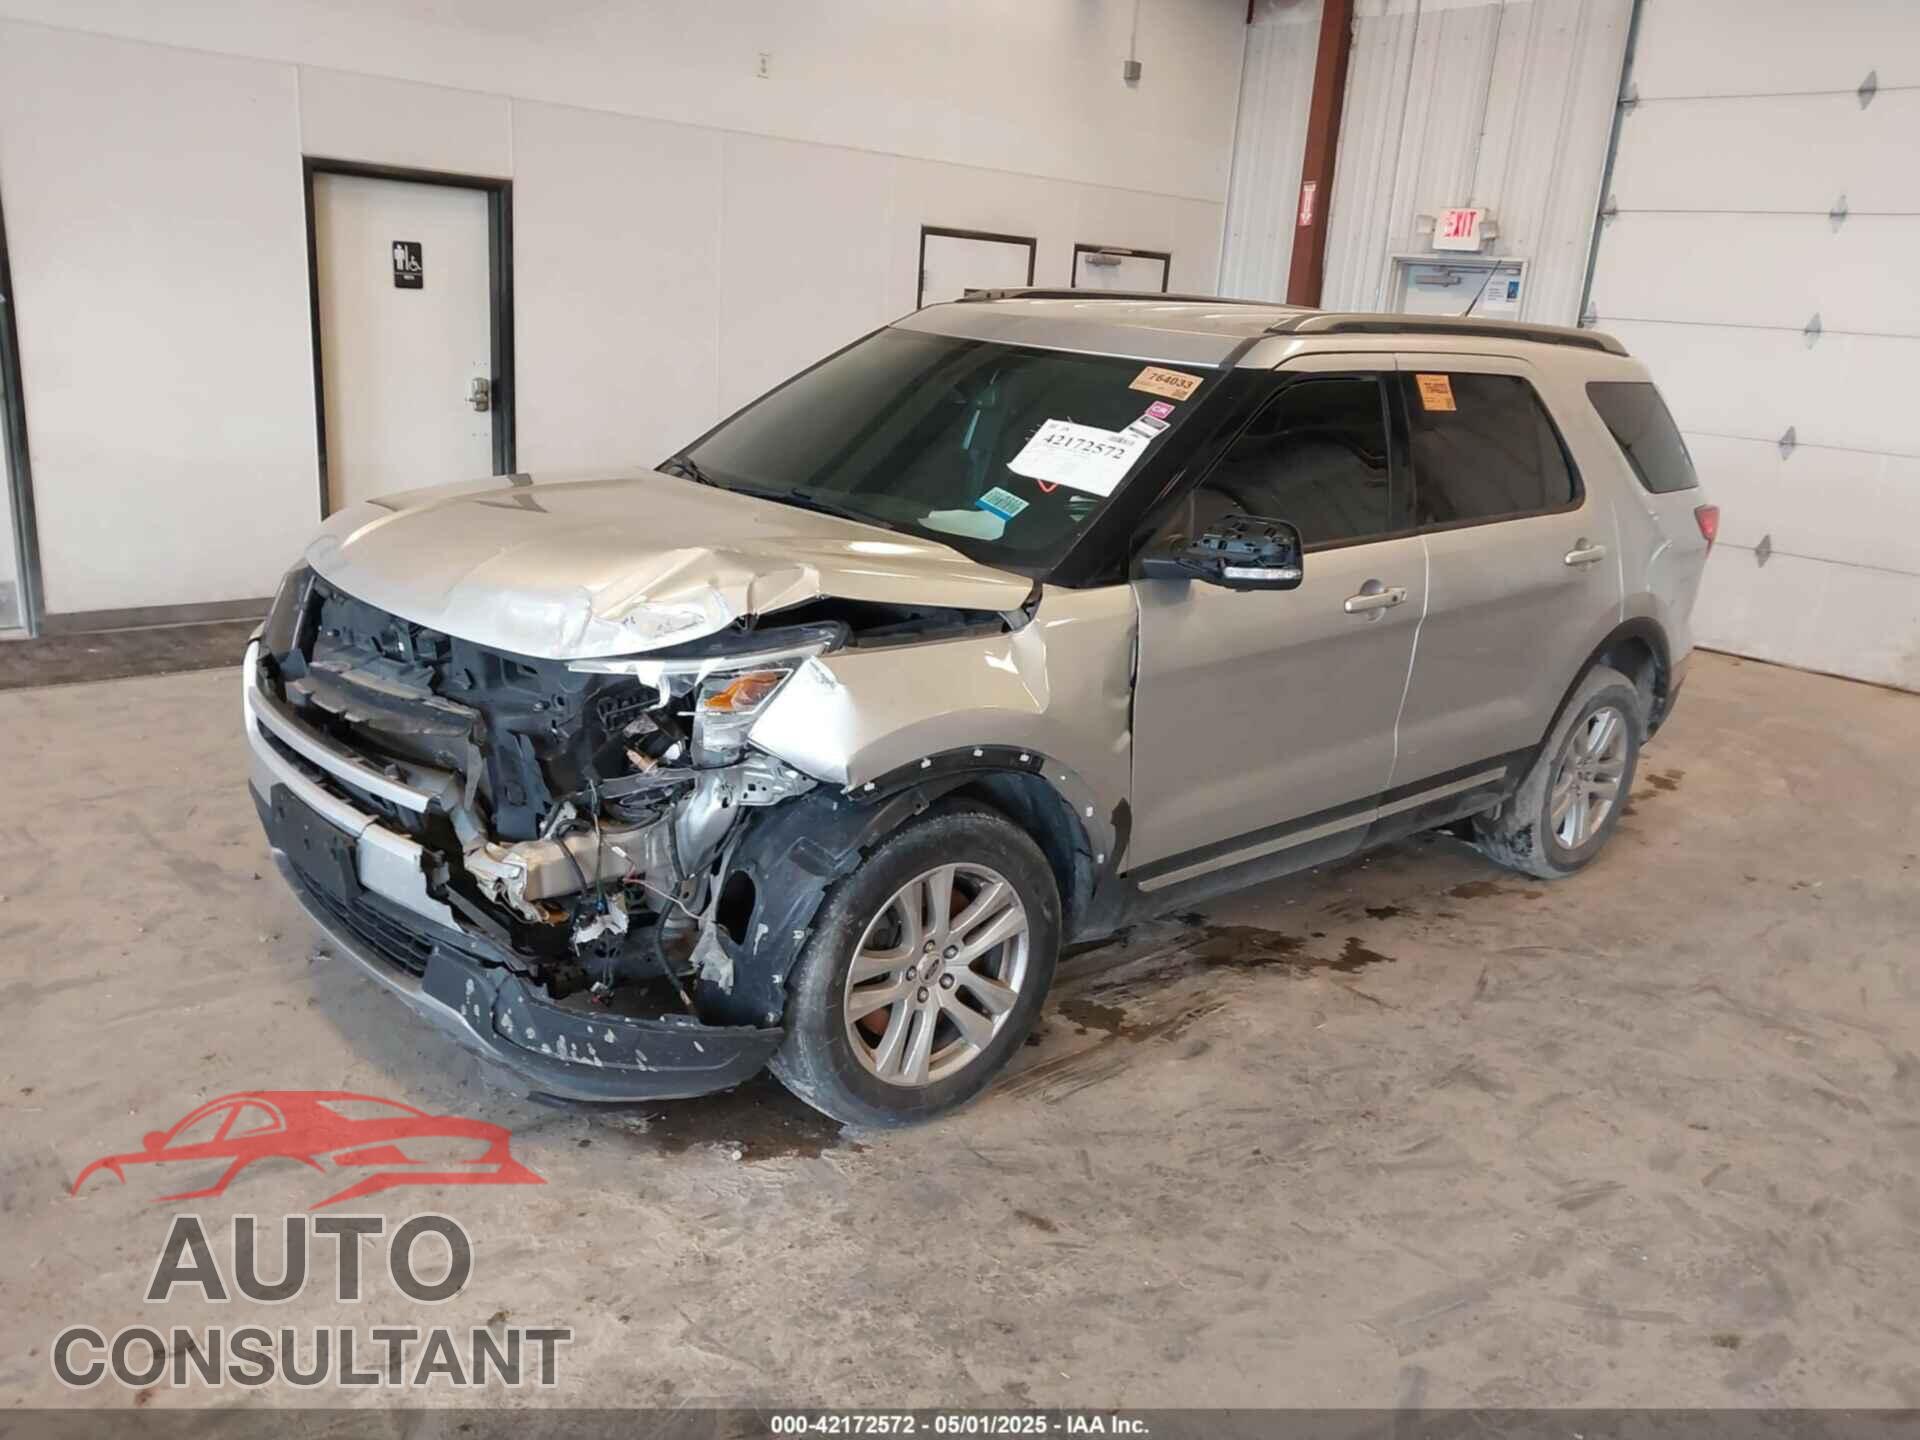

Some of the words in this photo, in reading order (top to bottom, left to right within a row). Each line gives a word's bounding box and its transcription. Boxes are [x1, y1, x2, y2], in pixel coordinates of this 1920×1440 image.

[1443, 211, 1477, 238] EXIT
[1149, 372, 1194, 390] 764033
[1043, 433, 1127, 460] 42172572
